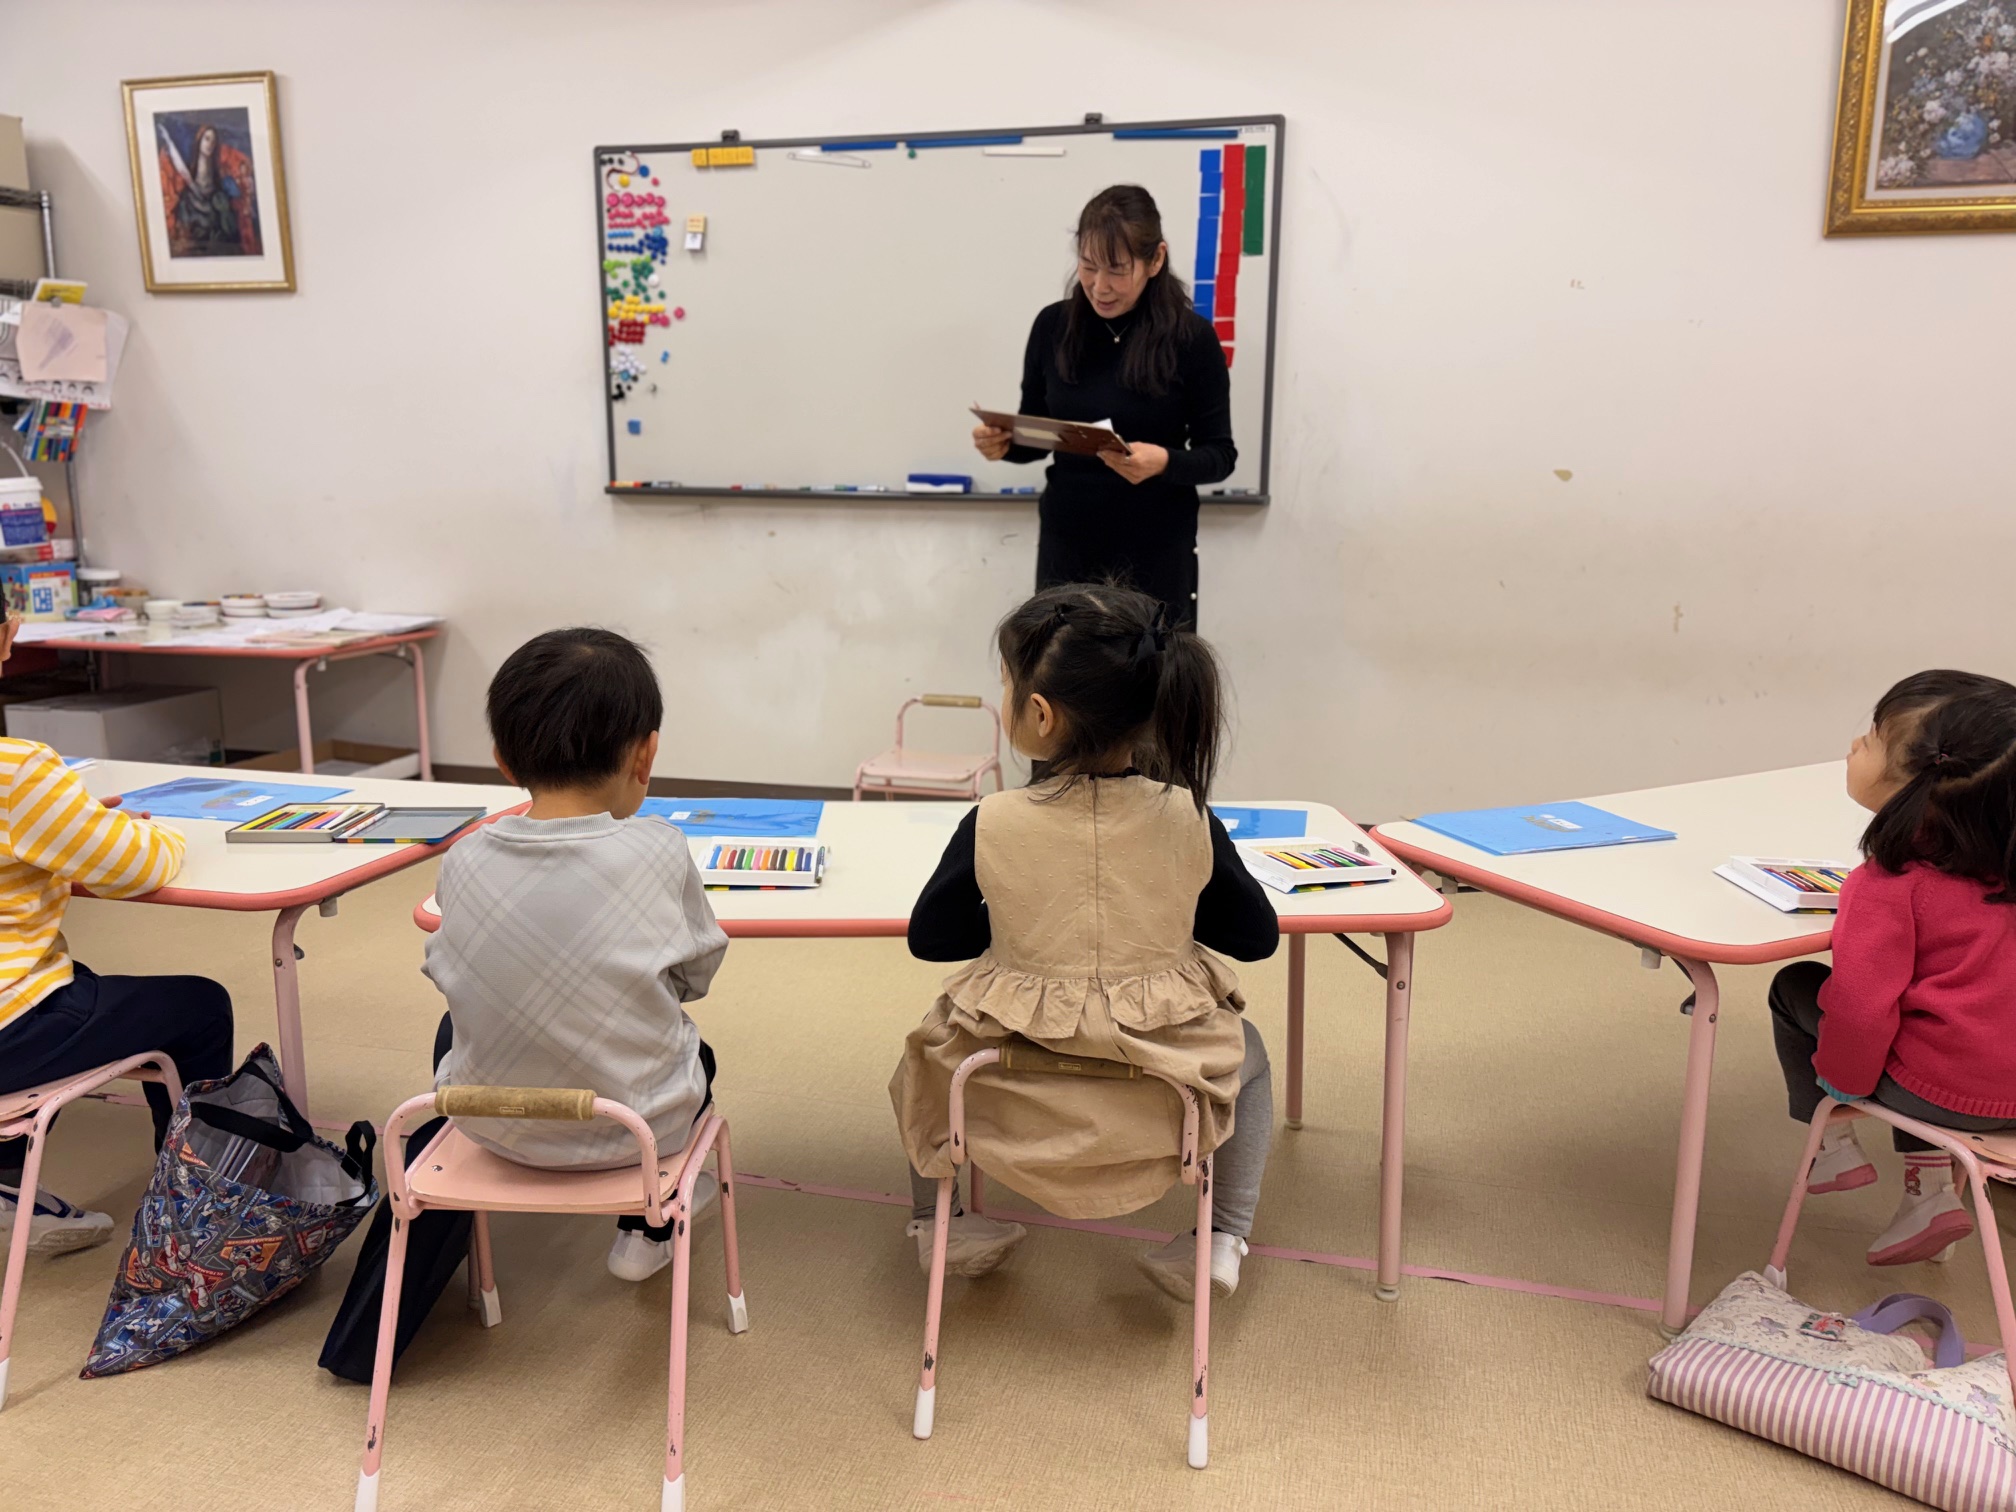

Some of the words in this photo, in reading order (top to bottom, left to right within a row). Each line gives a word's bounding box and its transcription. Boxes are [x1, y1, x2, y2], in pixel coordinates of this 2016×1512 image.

[180, 1201, 198, 1224] ULTRAMAN
[194, 1189, 206, 1202] ZERO
[165, 1316, 188, 1337] ULTRAMAN
[155, 1333, 167, 1346] ZERO
